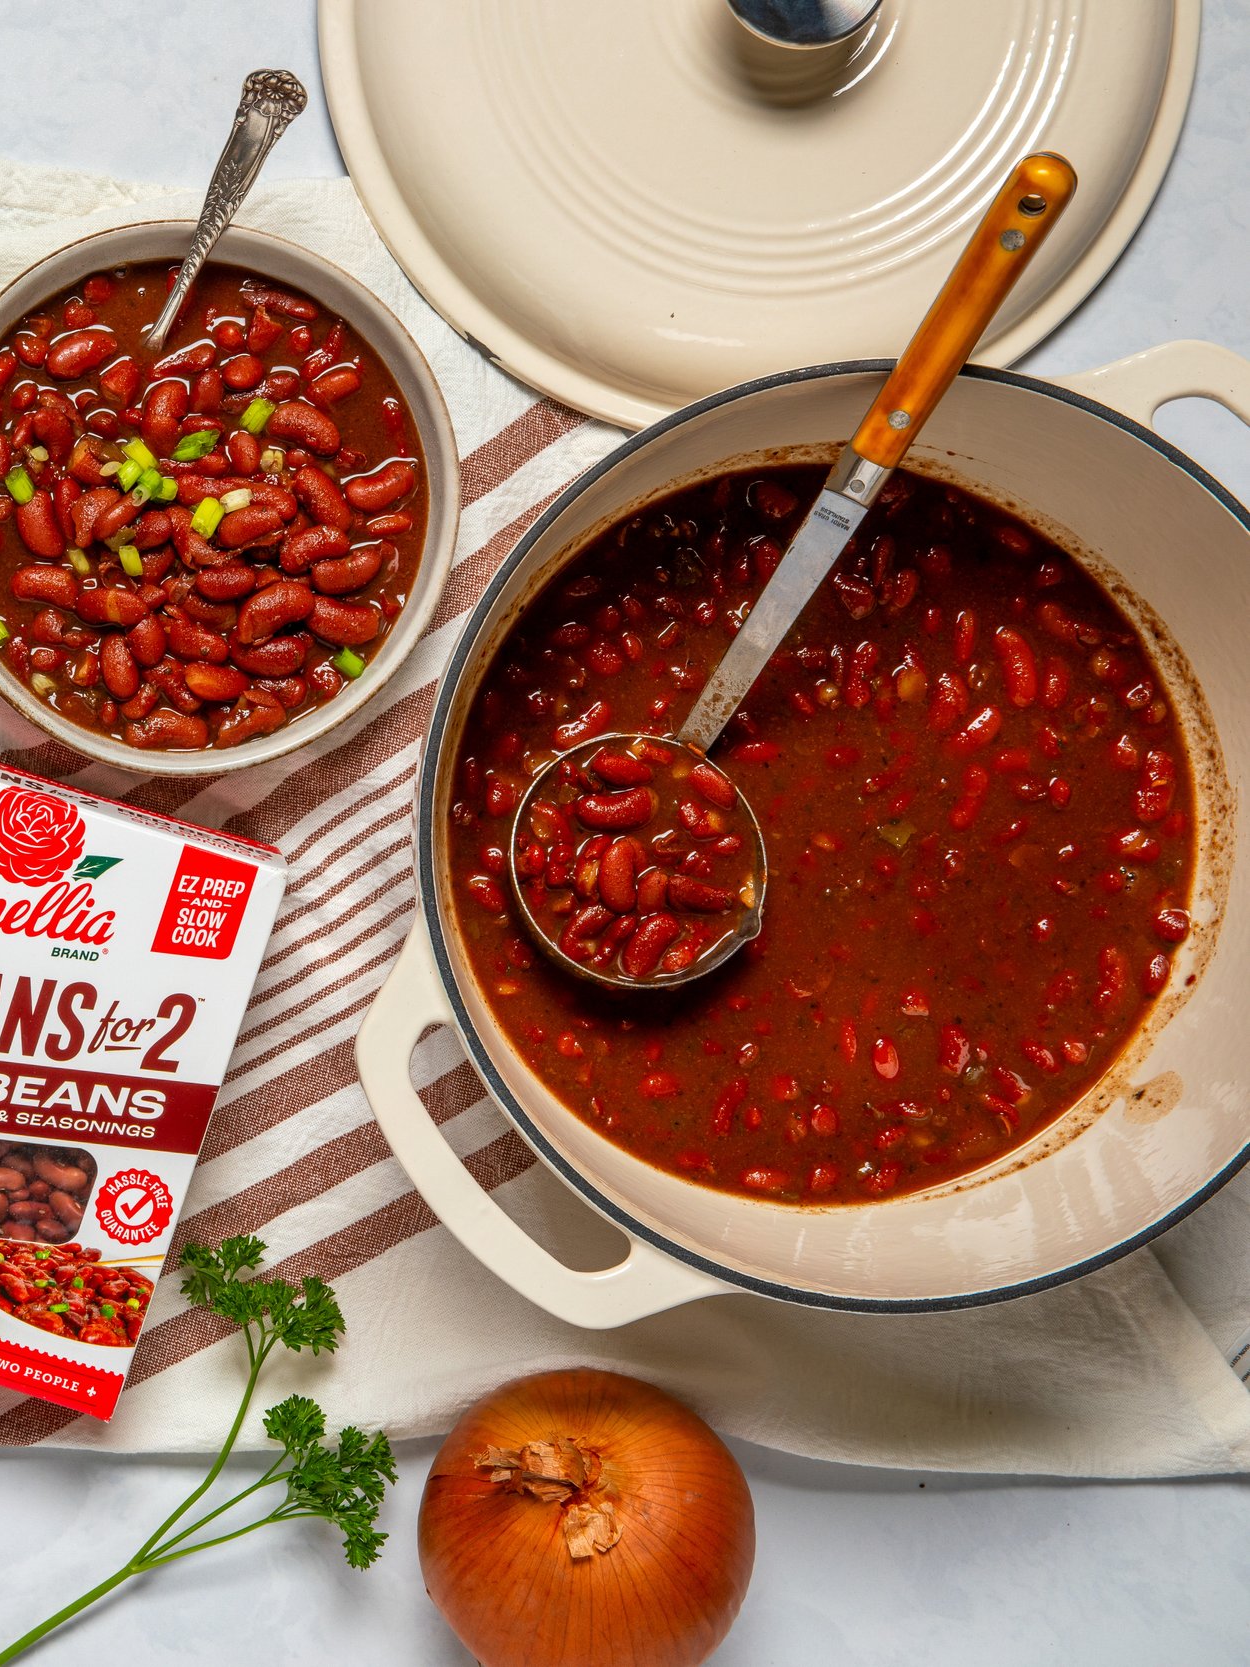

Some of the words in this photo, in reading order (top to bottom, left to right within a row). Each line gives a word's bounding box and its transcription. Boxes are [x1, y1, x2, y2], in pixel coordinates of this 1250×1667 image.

[821, 506, 850, 524] STAINLESS
[79, 796, 98, 808] 2
[177, 874, 199, 894] EZ
[200, 879, 246, 900] PREP
[177, 908, 228, 928] SLOW
[171, 926, 221, 949] COOK
[87, 1000, 158, 1054] for
[16, 1112, 156, 1139] SEASONINGS
[100, 1209, 160, 1241] GUARANTEE
[24, 1366, 80, 1393] PEOPLE
